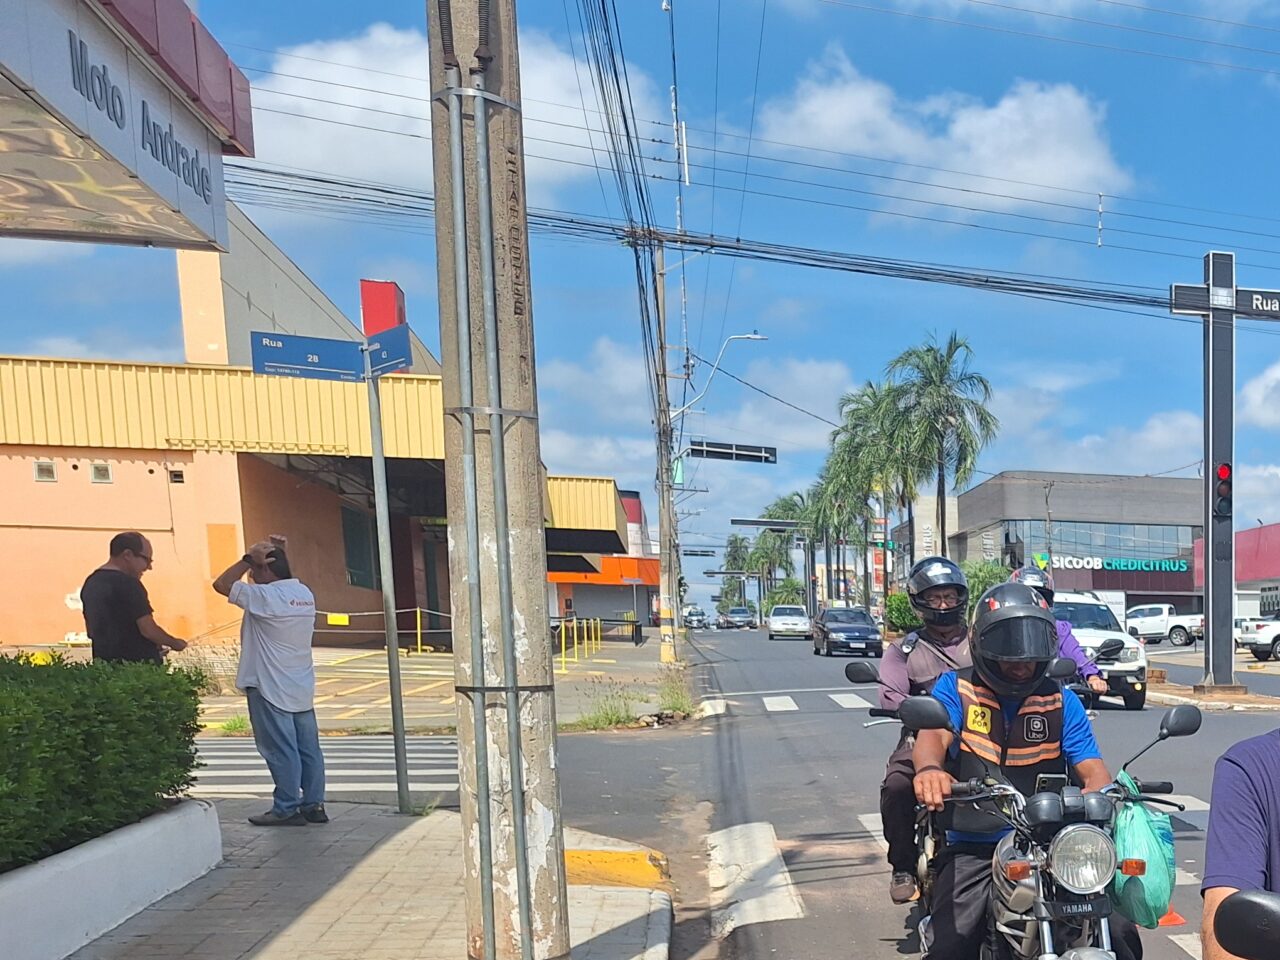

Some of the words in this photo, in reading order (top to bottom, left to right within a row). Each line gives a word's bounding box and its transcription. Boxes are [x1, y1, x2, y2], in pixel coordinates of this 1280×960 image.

[68, 29, 126, 130] Moto
[141, 100, 213, 205] Andrade
[1252, 294, 1280, 311] Rua
[262, 338, 283, 348] Rua
[307, 354, 319, 363] 28
[922, 524, 933, 558] CITRUS
[1052, 556, 1102, 570] SICOOB
[1103, 557, 1188, 572] CREDICITRUS
[973, 710, 987, 721] 99
[1028, 731, 1045, 739] Uber
[1062, 903, 1093, 914] YAMAHA
